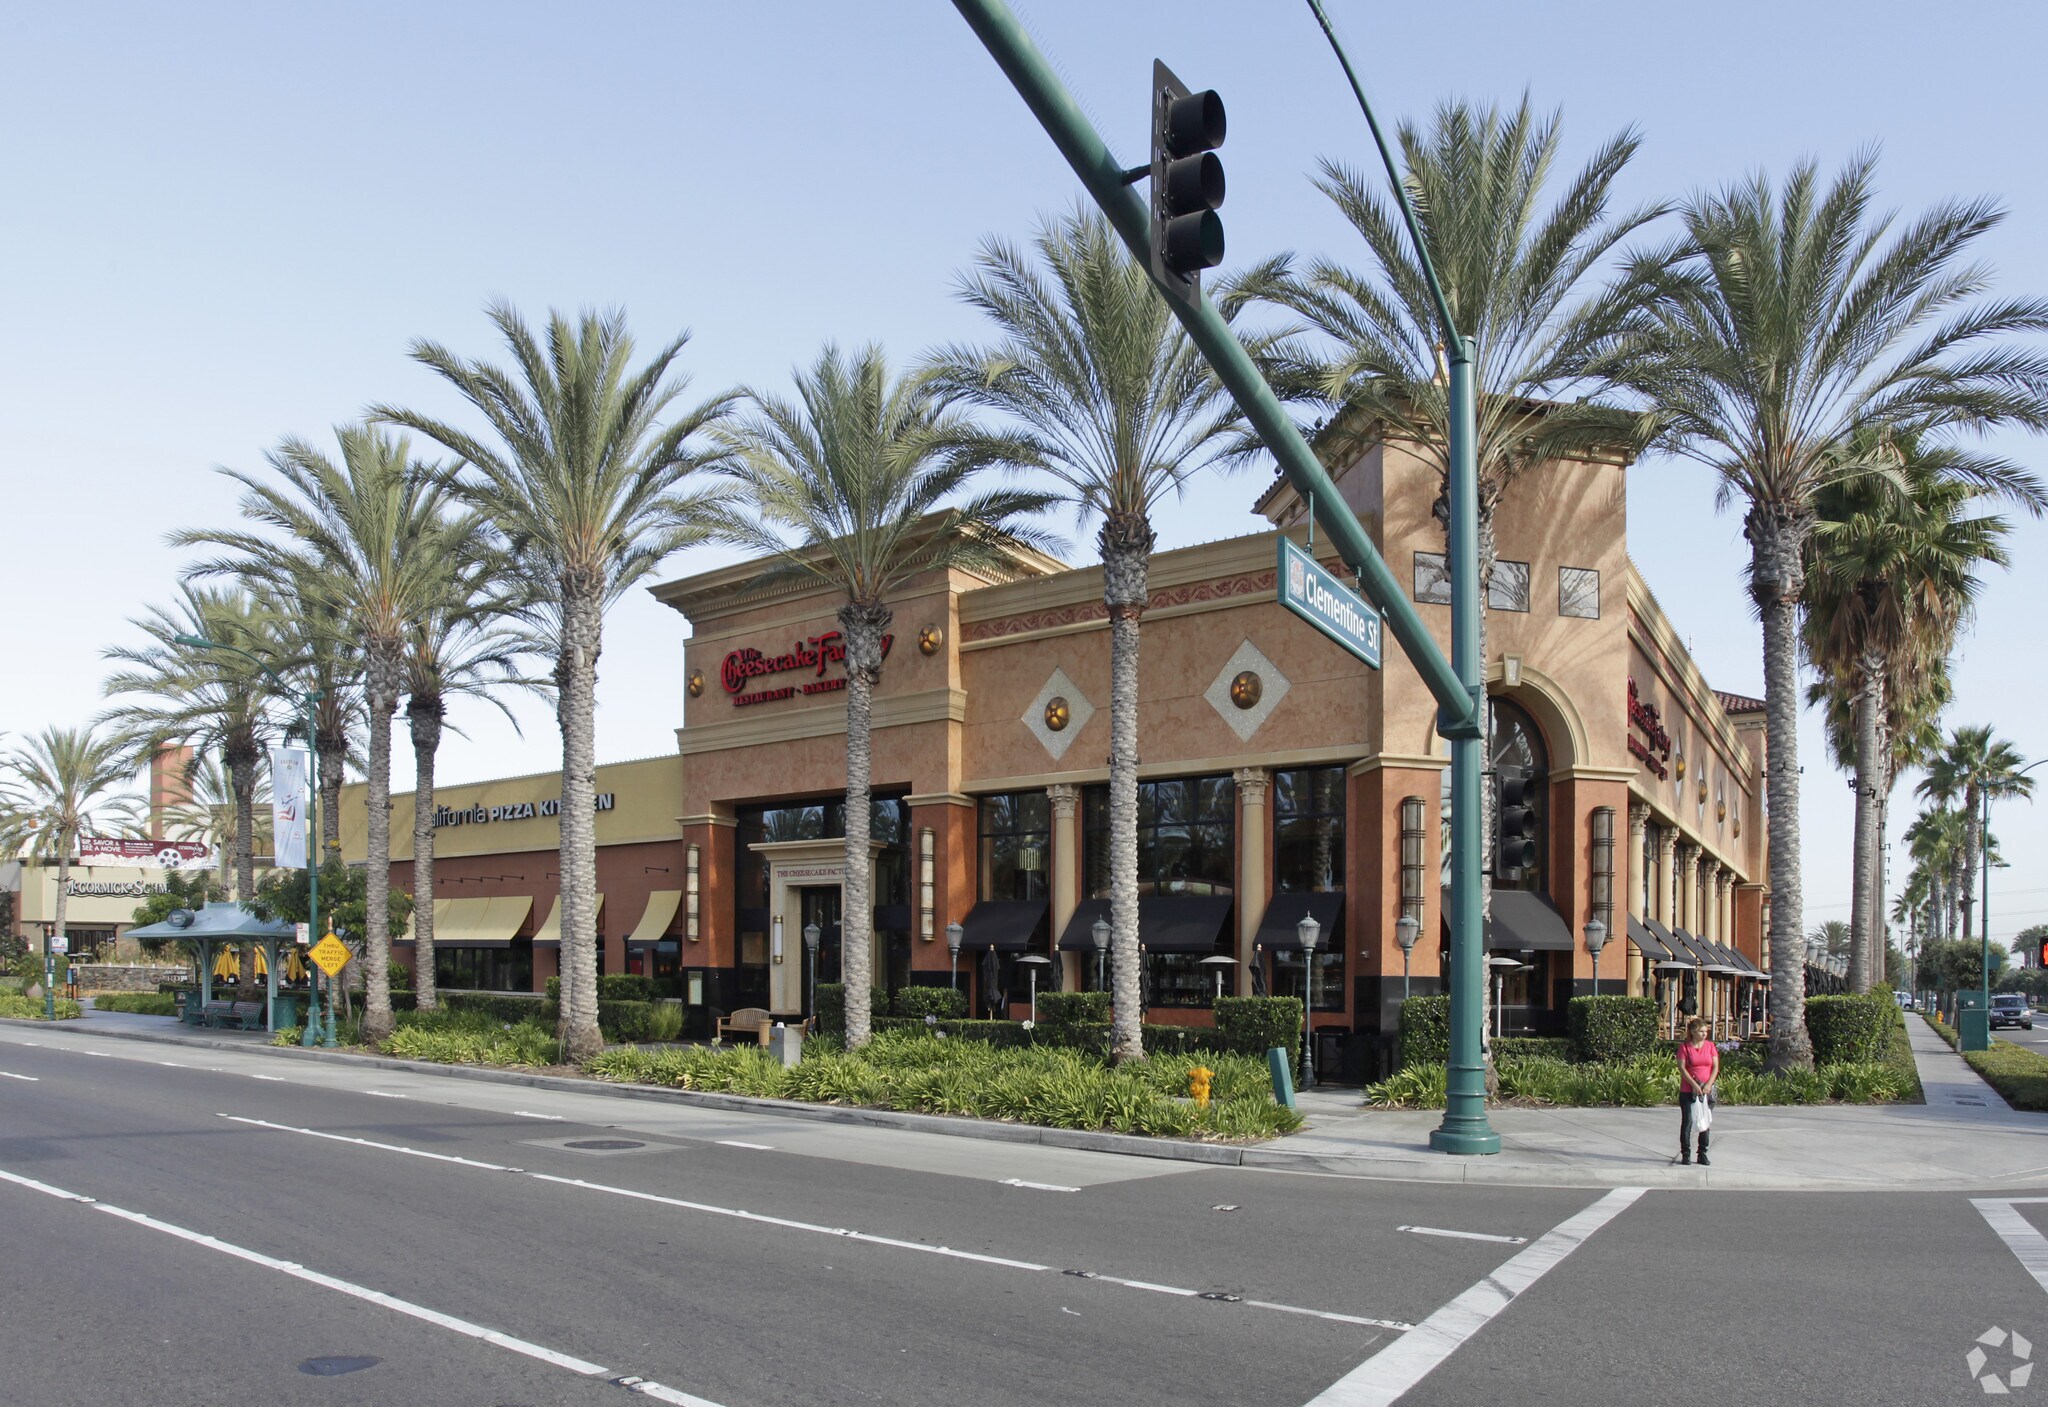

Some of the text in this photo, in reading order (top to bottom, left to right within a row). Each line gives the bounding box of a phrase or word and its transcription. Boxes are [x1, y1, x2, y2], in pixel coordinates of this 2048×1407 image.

[1306, 573, 1378, 651] Clementine St
[721, 640, 816, 694] Cheesecake
[732, 679, 847, 706] RESTAURANT BAKERY
[491, 802, 536, 822] PIZZA
[539, 793, 614, 817] KITN
[777, 870, 789, 878] THE
[789, 868, 827, 877] CHEESECAKE
